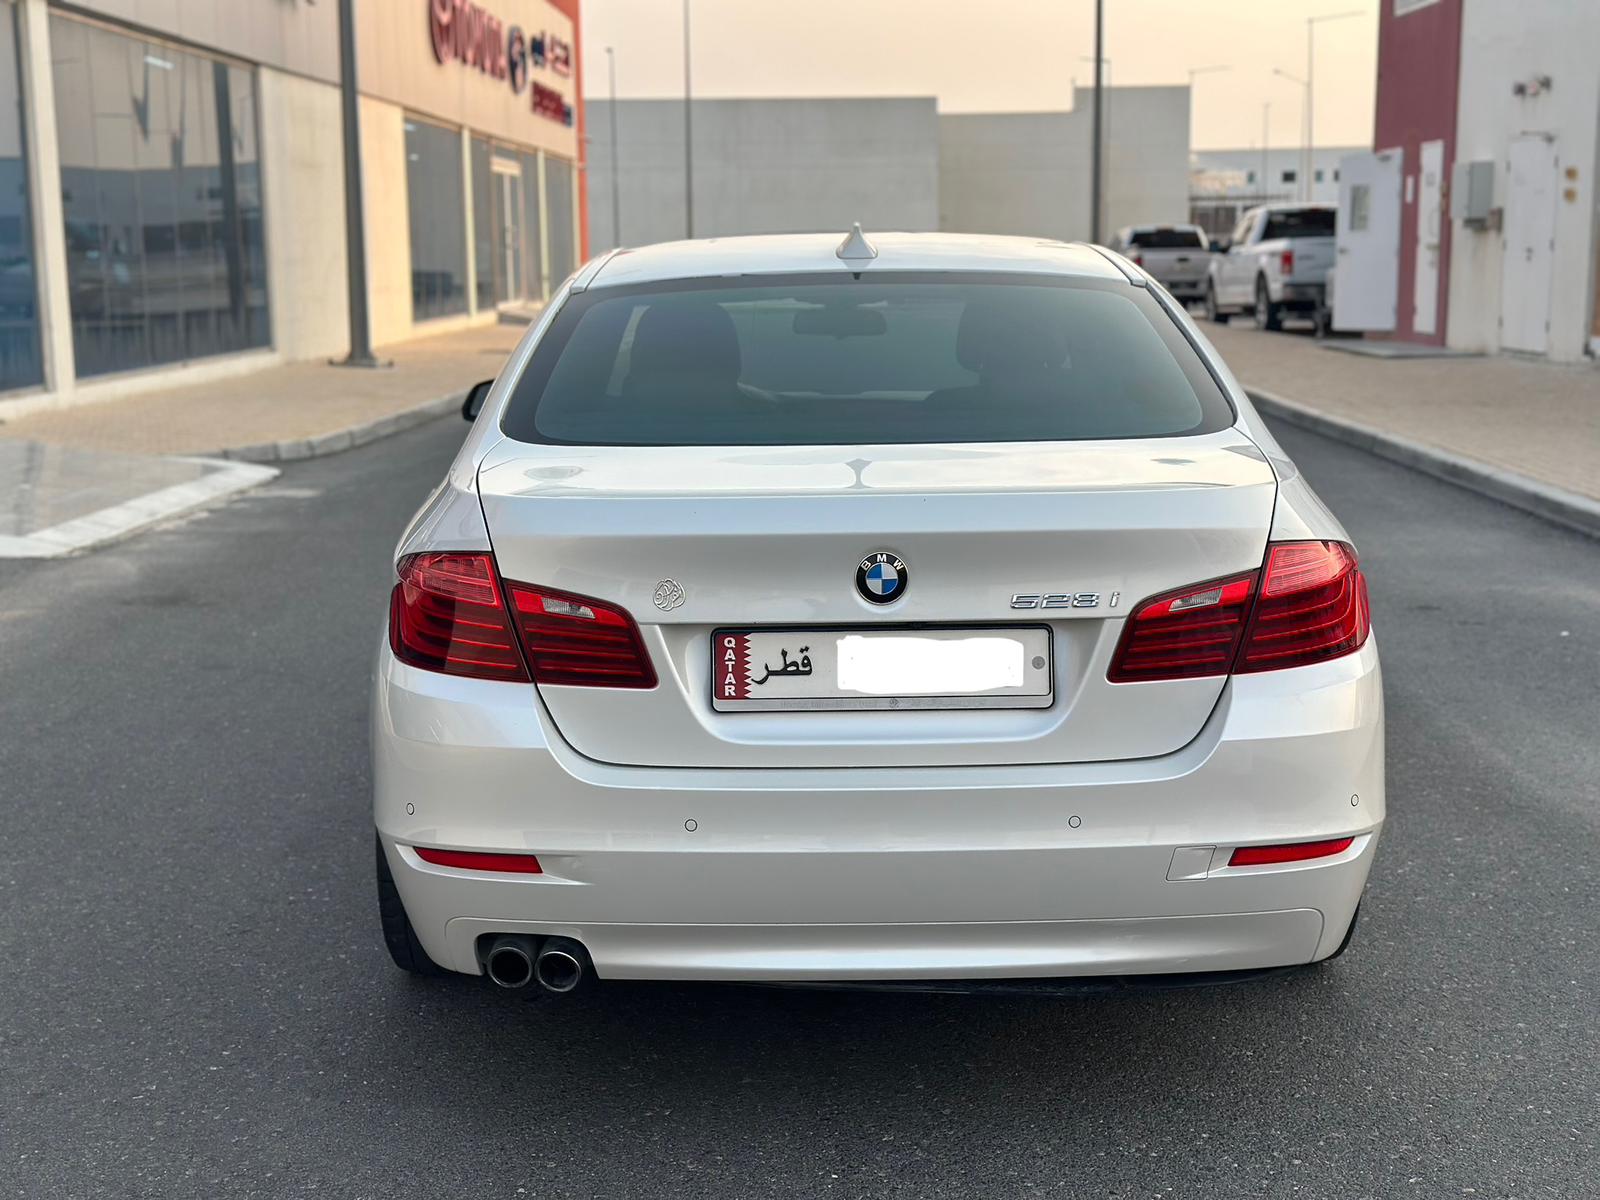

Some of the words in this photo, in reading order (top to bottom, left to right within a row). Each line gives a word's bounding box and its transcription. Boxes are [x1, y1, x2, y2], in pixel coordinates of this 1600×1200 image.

[861, 553, 904, 571] BMW
[723, 637, 737, 697] QATAR
[751, 646, 813, 685] قطر
